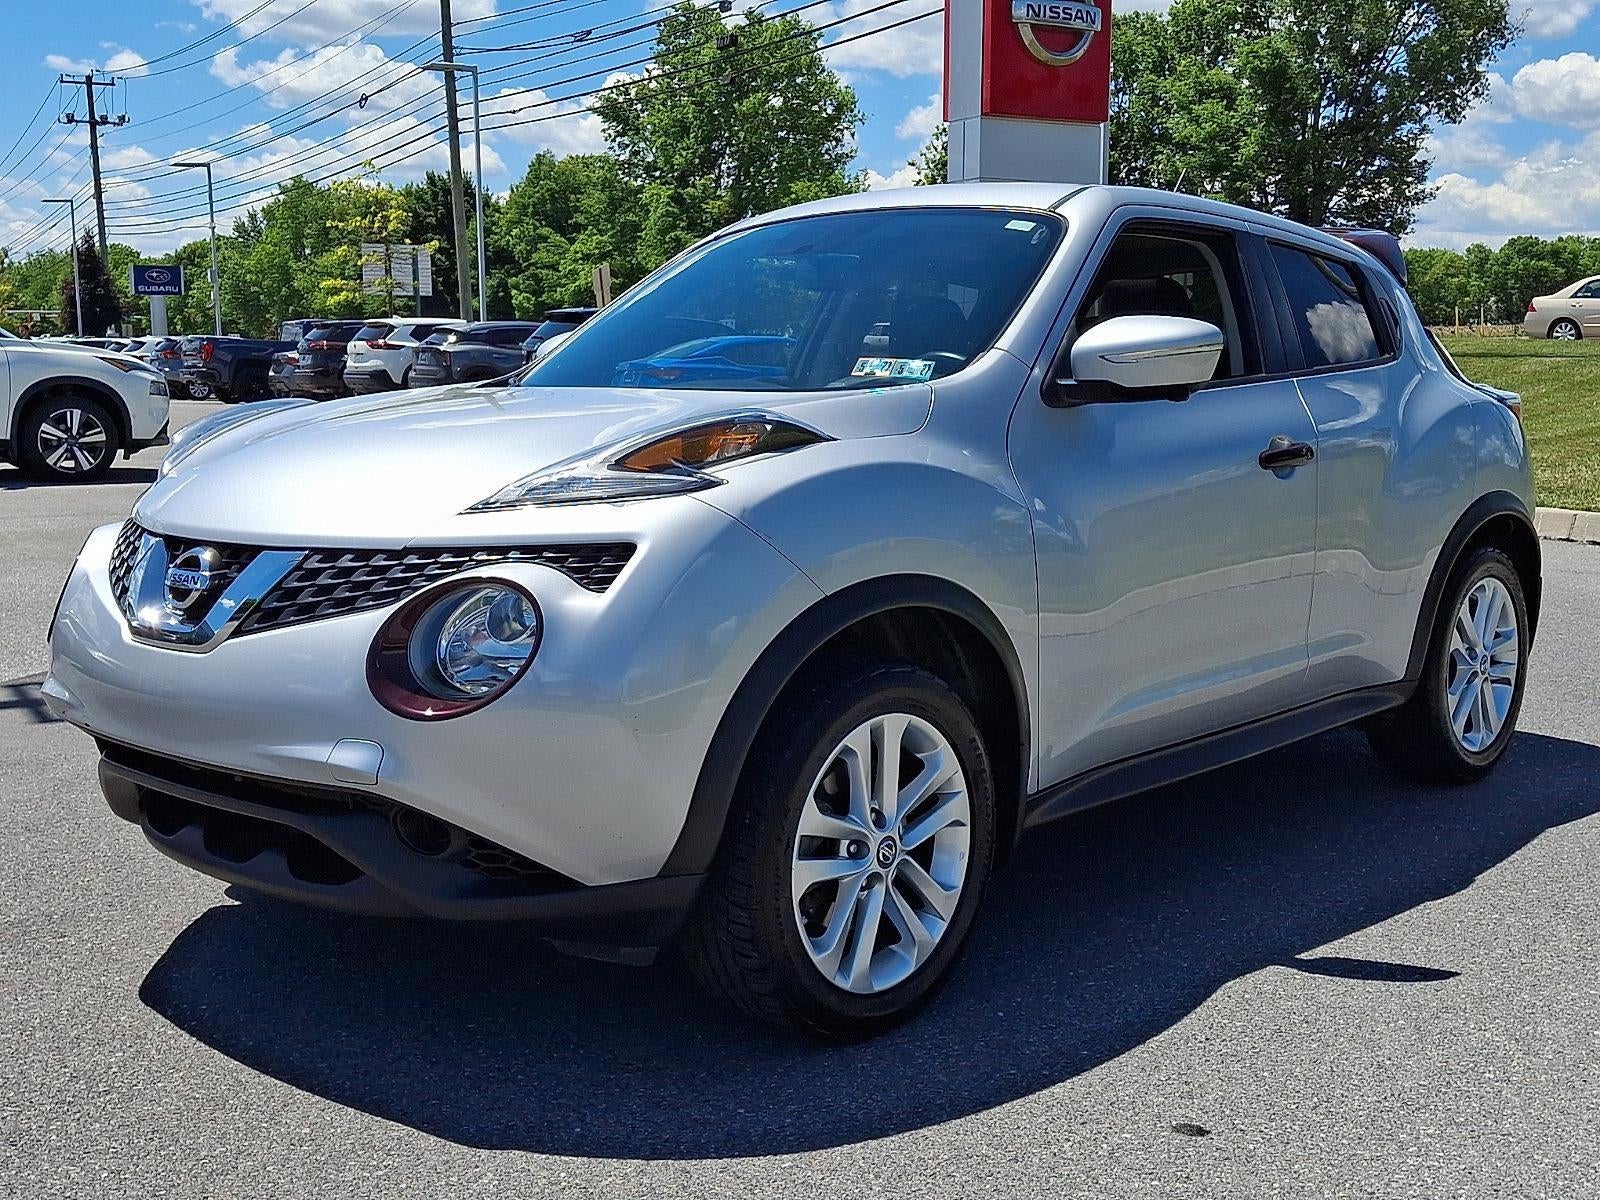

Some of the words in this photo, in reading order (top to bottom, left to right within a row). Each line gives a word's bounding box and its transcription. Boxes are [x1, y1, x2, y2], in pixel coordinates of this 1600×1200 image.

[1026, 3, 1097, 25] NISSAN
[857, 362, 867, 373] 5
[896, 364, 906, 375] 5
[920, 363, 932, 377] 27
[167, 572, 200, 586] ISSAN
